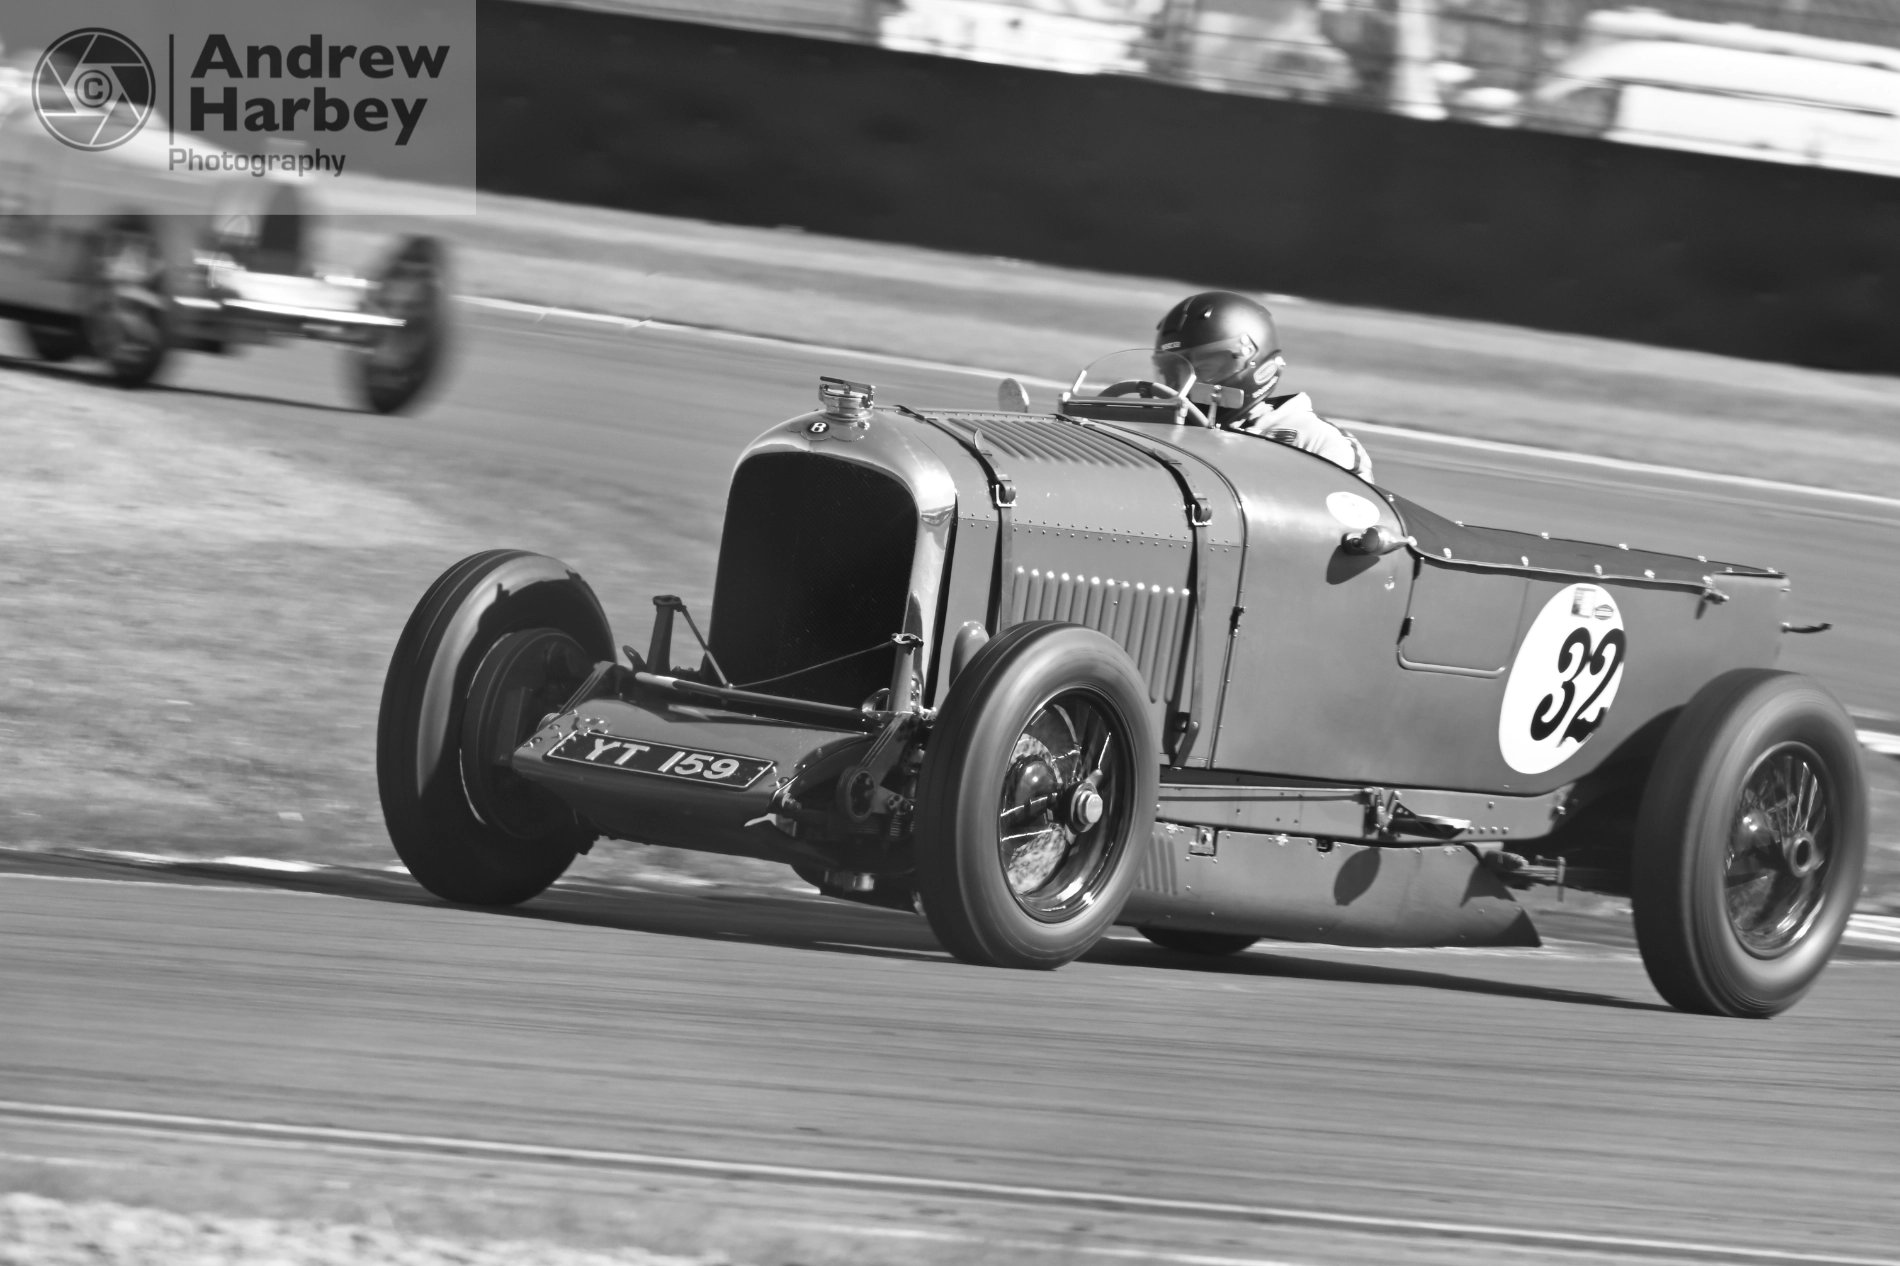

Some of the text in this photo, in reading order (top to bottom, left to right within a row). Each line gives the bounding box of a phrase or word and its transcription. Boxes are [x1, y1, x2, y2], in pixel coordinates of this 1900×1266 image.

[810, 422, 827, 433] B
[1530, 626, 1627, 748] 32
[585, 738, 740, 779] YT 159
